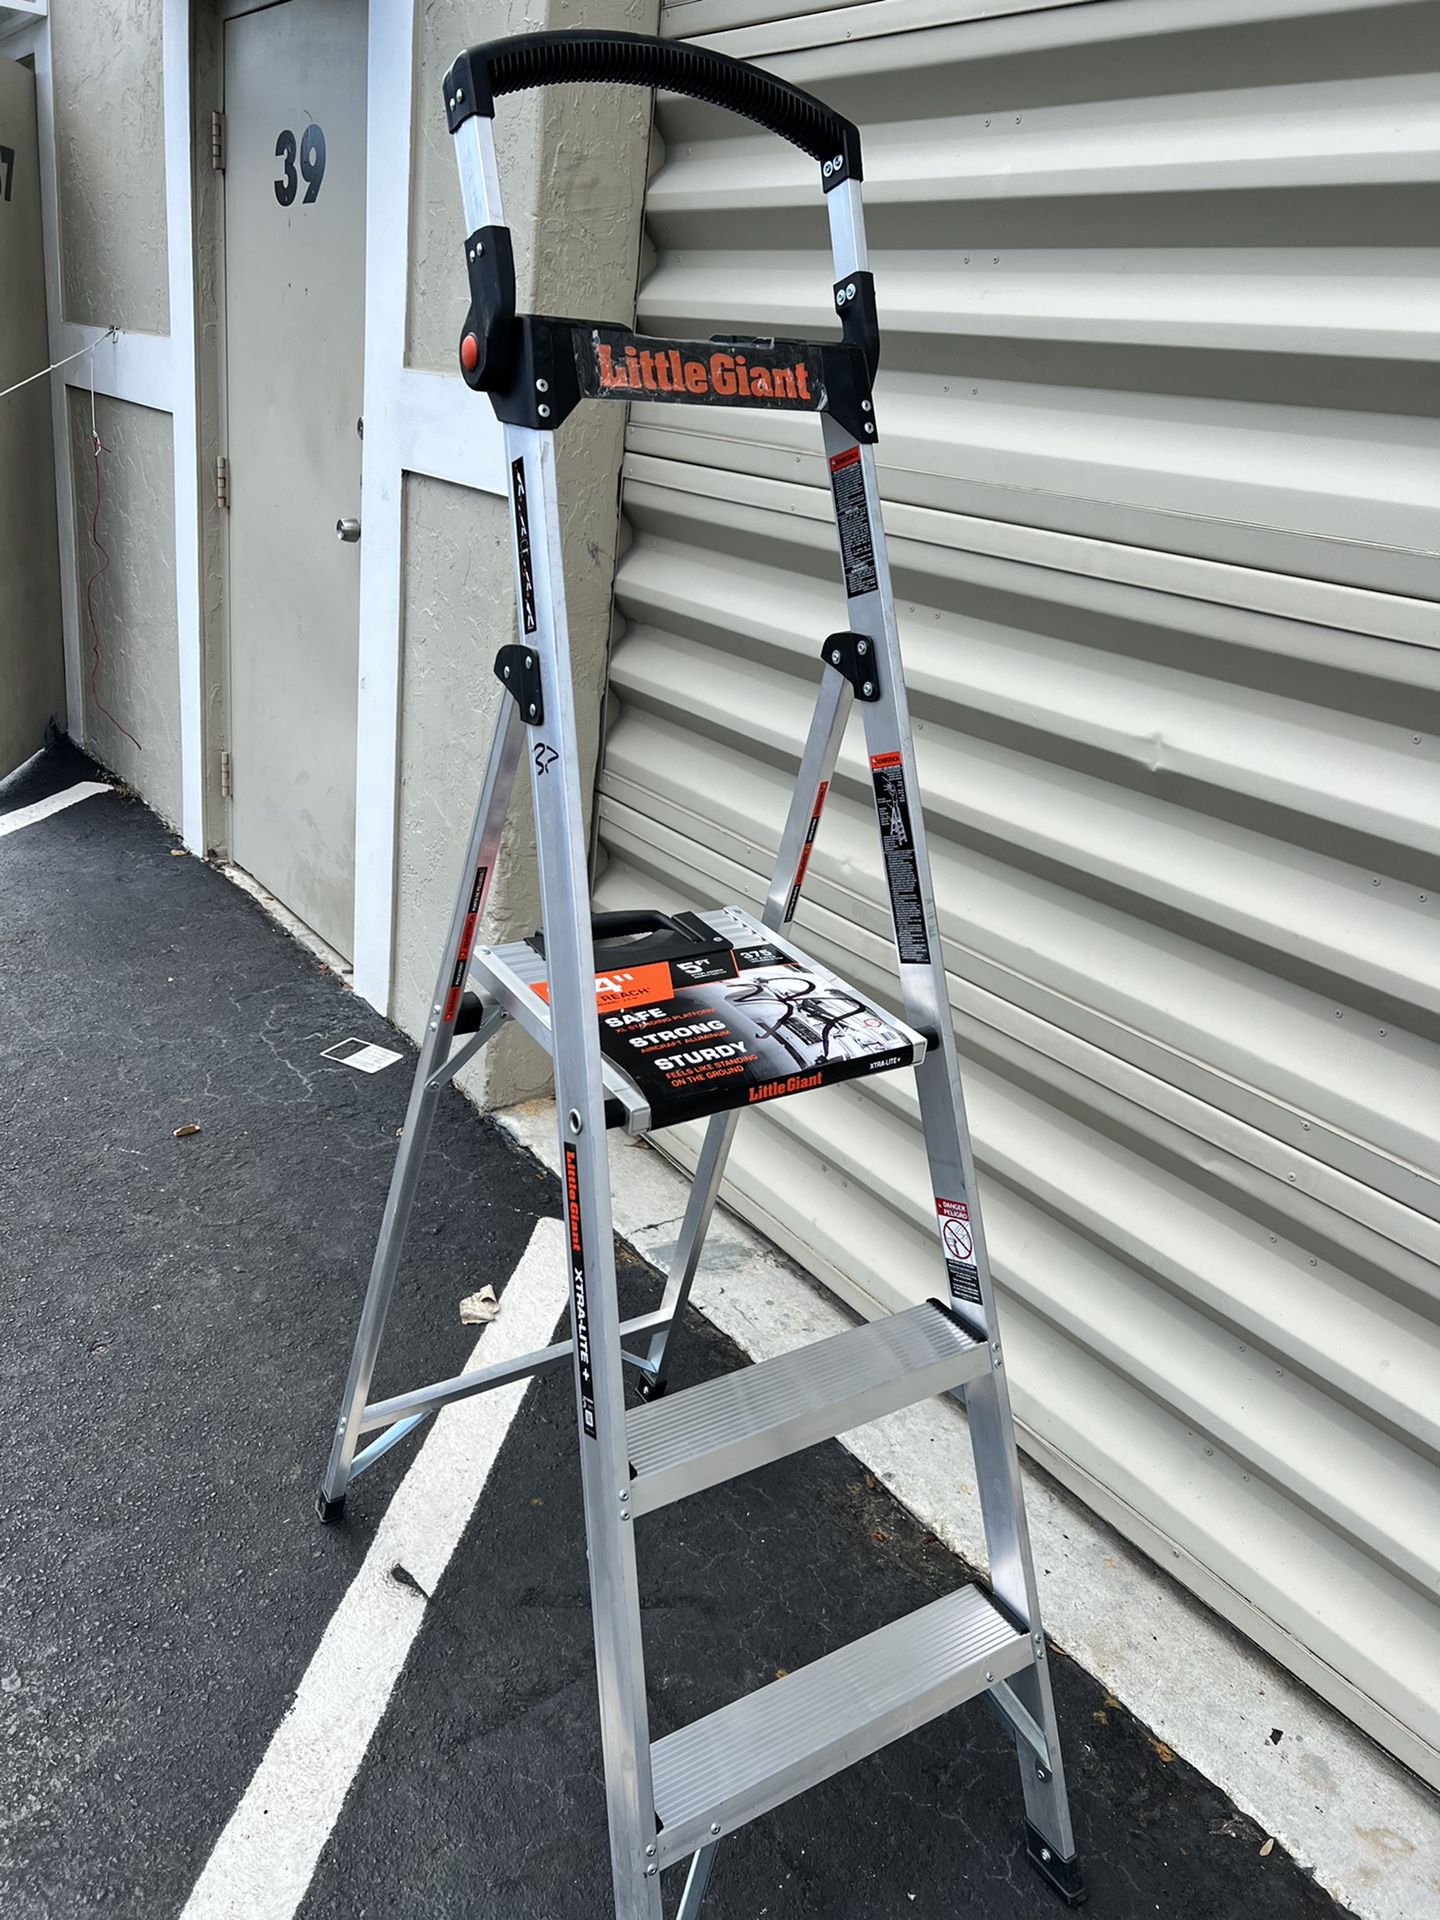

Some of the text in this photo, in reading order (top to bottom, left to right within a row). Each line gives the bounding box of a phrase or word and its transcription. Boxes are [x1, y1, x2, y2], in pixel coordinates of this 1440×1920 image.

[0, 144, 15, 202] 7
[274, 124, 326, 207] 39
[604, 1007, 667, 1028] SAFE
[672, 1008, 716, 1021] PLATFORM
[629, 1020, 726, 1048] STRONG
[641, 1030, 731, 1054] AIRCRAFT ALUMINUM
[654, 1041, 747, 1071] STURDY
[665, 1054, 758, 1079] FEELS LIKE STANDING
[671, 1065, 744, 1087] ON THE GROUND
[943, 1201, 967, 1212] DANGER
[943, 1208, 968, 1219] PELIGRO
